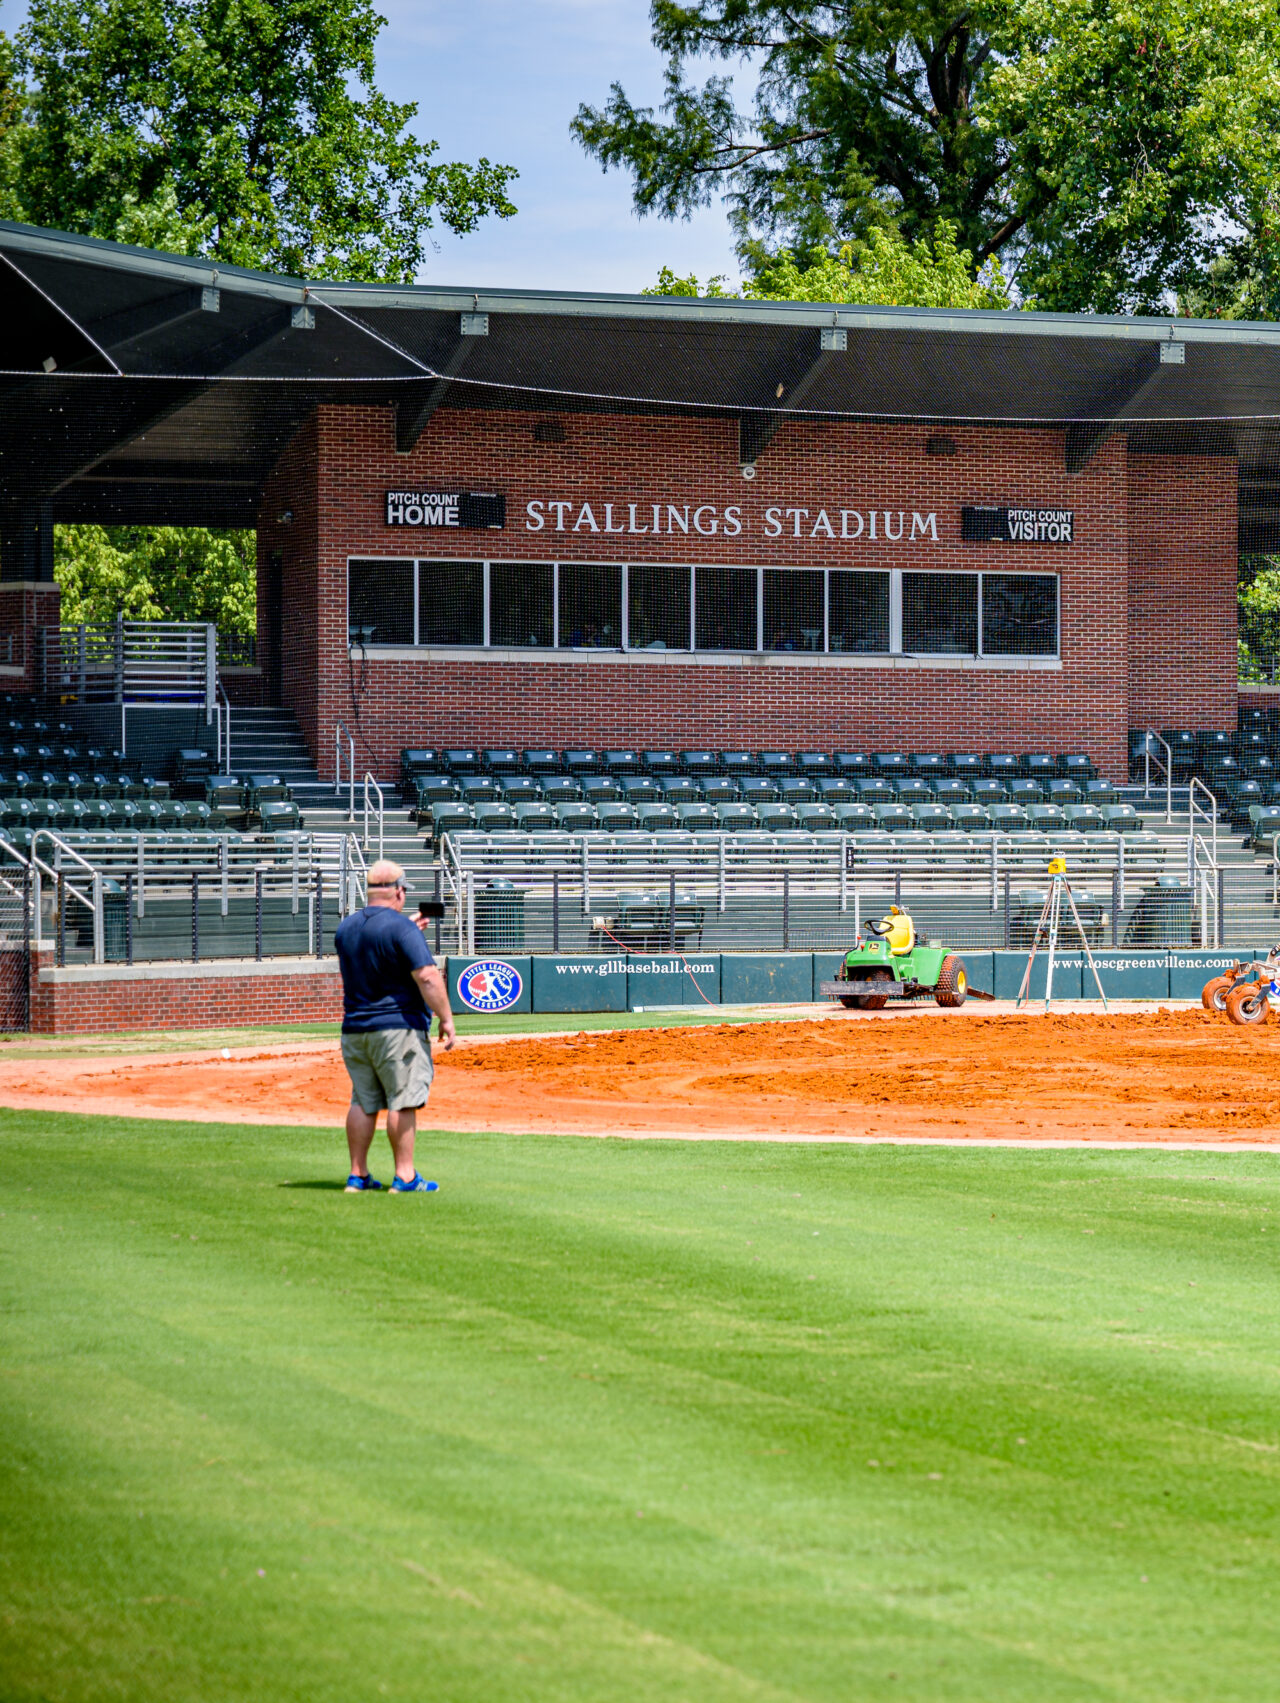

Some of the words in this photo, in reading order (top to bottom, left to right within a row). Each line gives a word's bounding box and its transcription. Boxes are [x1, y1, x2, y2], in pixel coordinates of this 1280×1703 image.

[388, 492, 420, 505] PITCH
[421, 494, 460, 506] COUNT
[387, 504, 460, 526] HOME
[525, 500, 743, 536] STALLINGS
[764, 507, 940, 541] STADIUM
[1008, 510, 1036, 522] PITCH
[1038, 511, 1073, 523] COUNT
[1008, 521, 1072, 542] VISITOR
[465, 963, 487, 980] LITTLE
[489, 963, 515, 979] LEAGUE
[555, 961, 715, 977] www.gllbaseball.com
[470, 996, 512, 1009] BASEBALL
